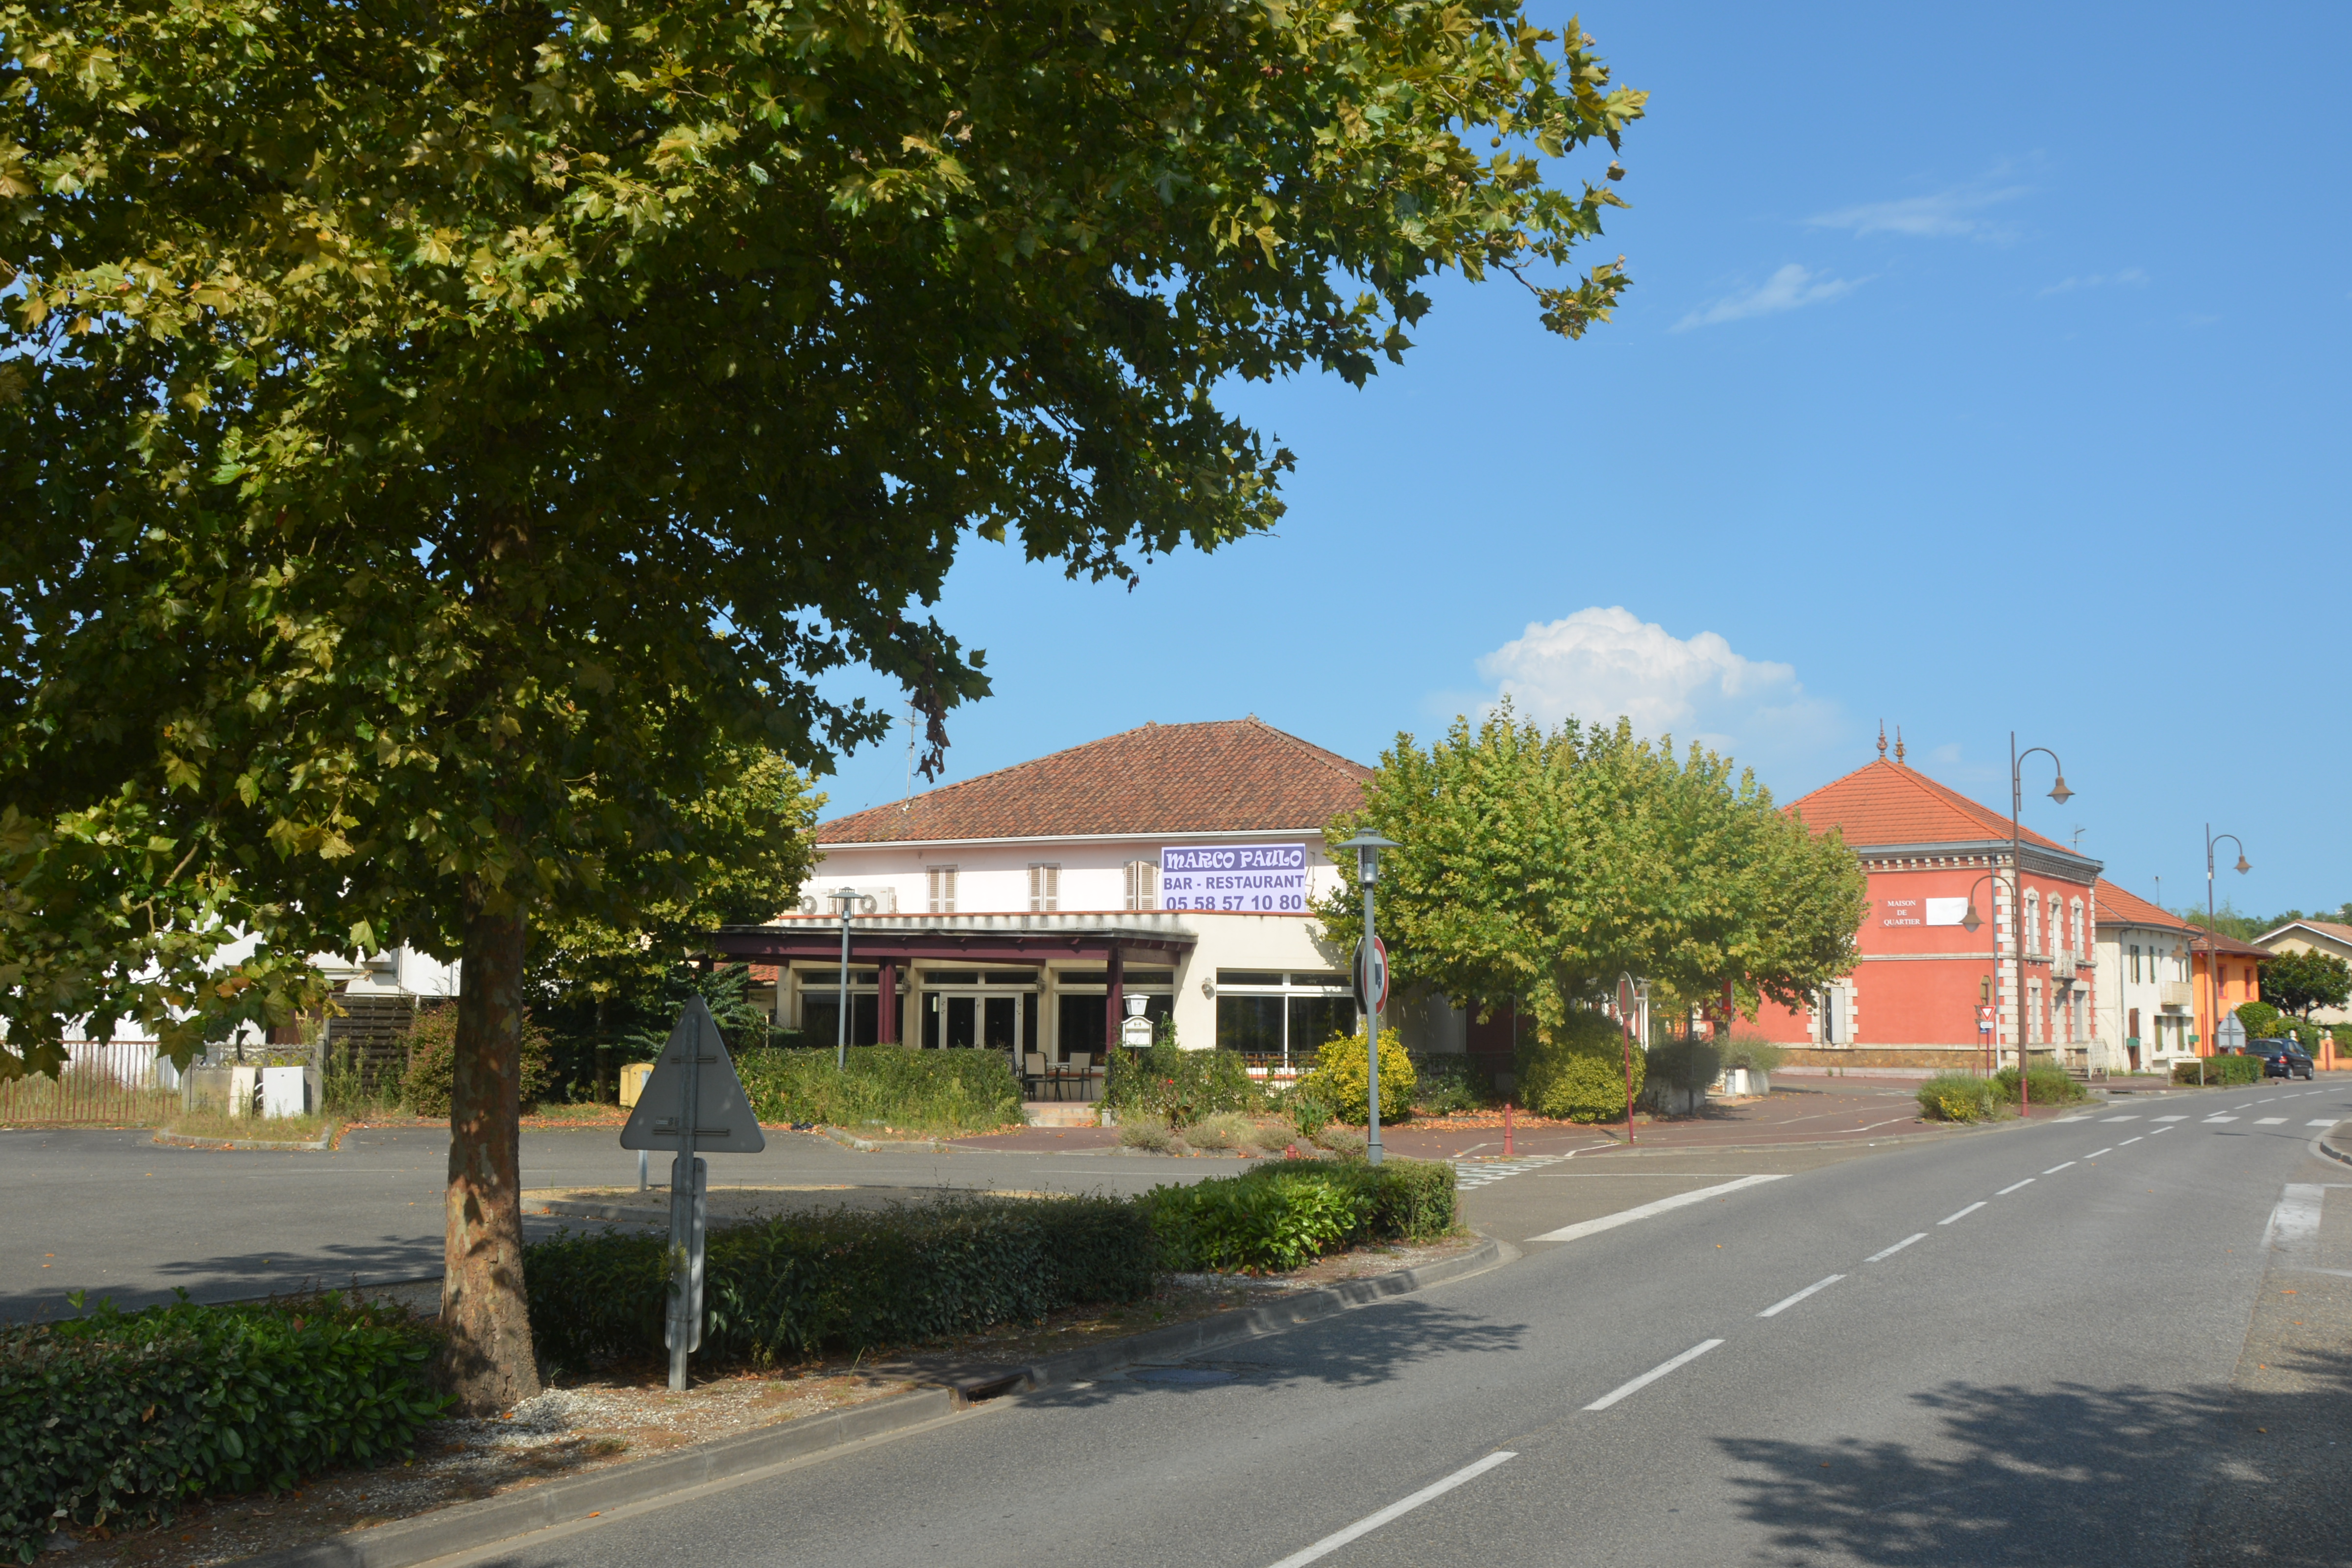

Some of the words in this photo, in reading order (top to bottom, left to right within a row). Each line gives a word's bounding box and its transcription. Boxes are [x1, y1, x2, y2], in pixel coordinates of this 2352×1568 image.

[1166, 851, 1235, 870] MARCO
[1240, 849, 1302, 868] PAULO
[1164, 878, 1192, 890] BAR
[1206, 875, 1304, 889] RESTAURANT
[1166, 897, 1187, 910] 05
[1194, 896, 1215, 910] 58
[1223, 896, 1244, 910] 57
[1251, 895, 1273, 910] 10
[1279, 895, 1301, 909] 80
